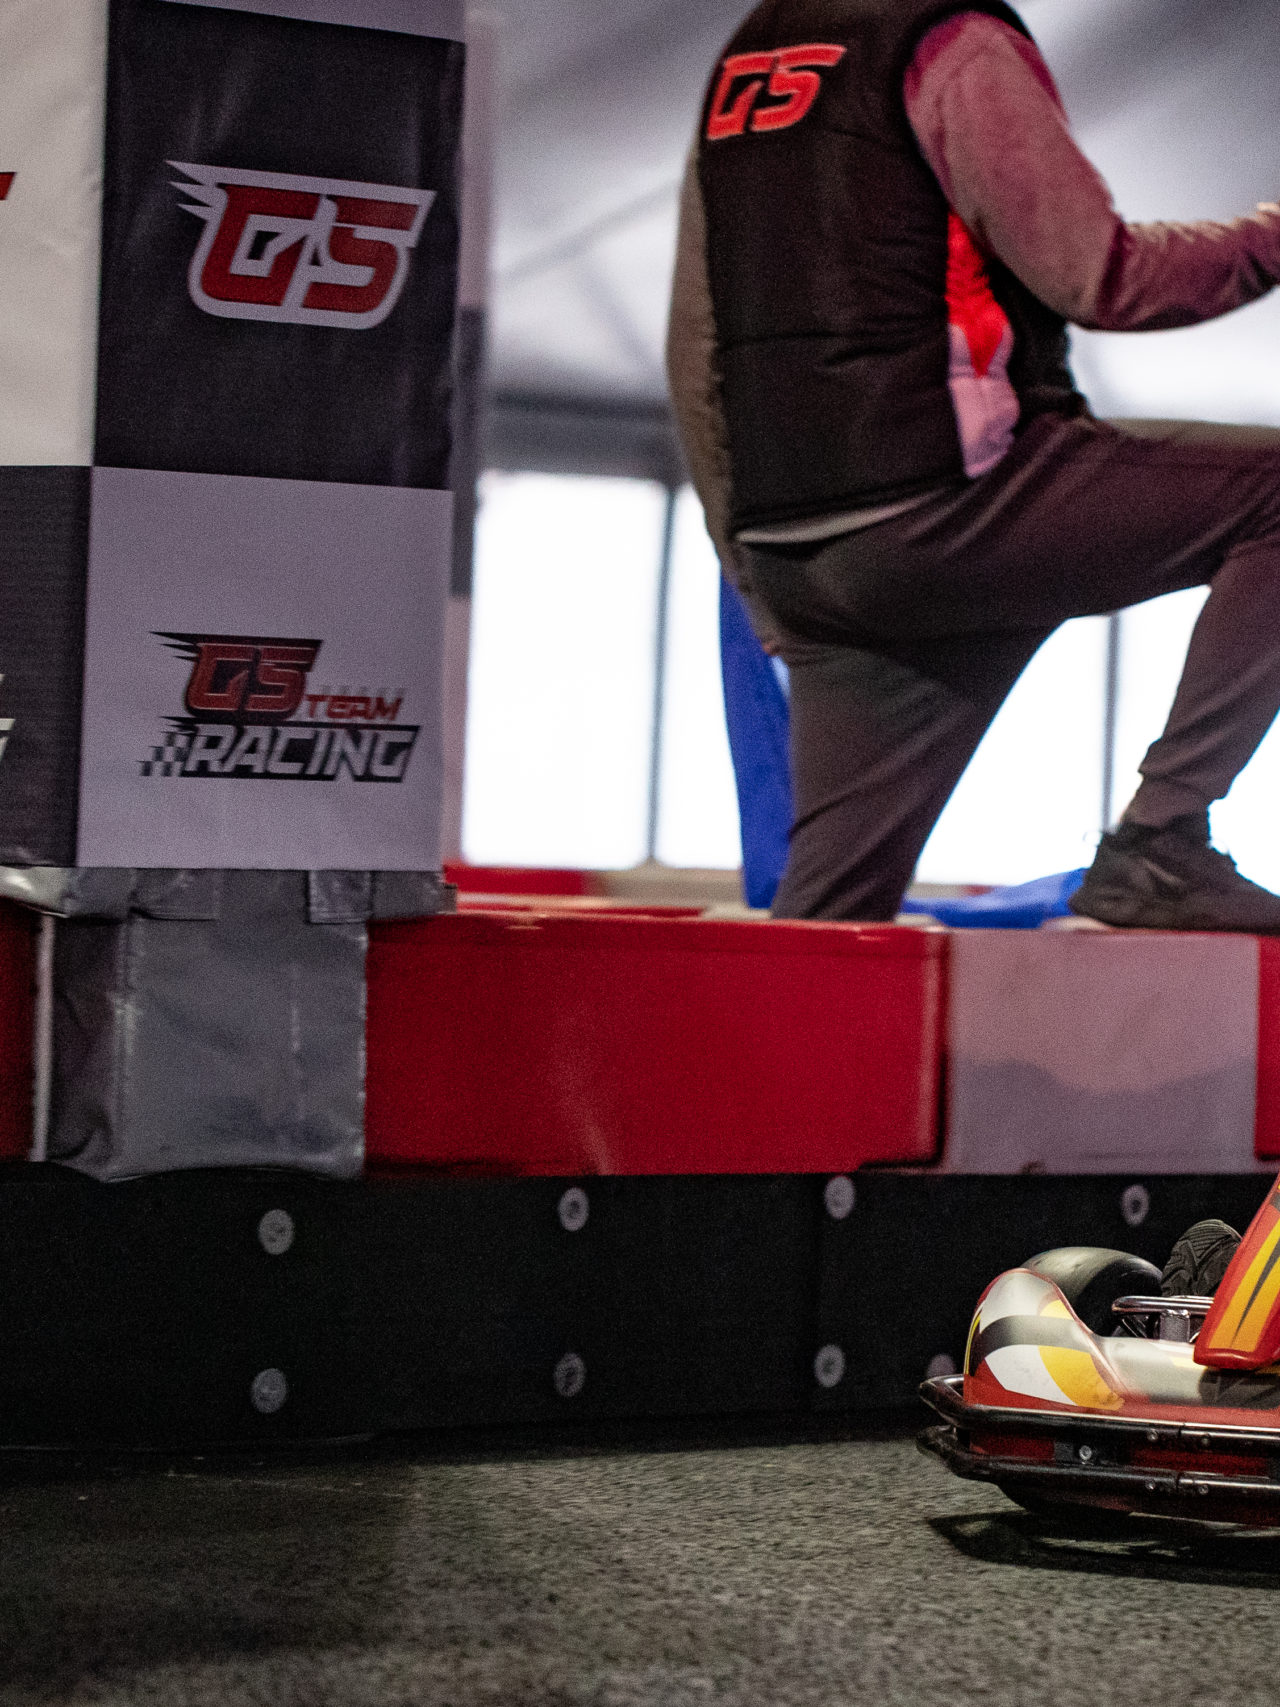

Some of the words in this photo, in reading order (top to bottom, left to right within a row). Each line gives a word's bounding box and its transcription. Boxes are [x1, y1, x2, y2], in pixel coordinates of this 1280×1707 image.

[707, 42, 847, 141] GS
[192, 172, 430, 322] GS
[184, 638, 322, 714] GS
[305, 694, 404, 721] TEAM
[182, 724, 418, 780] RACING
